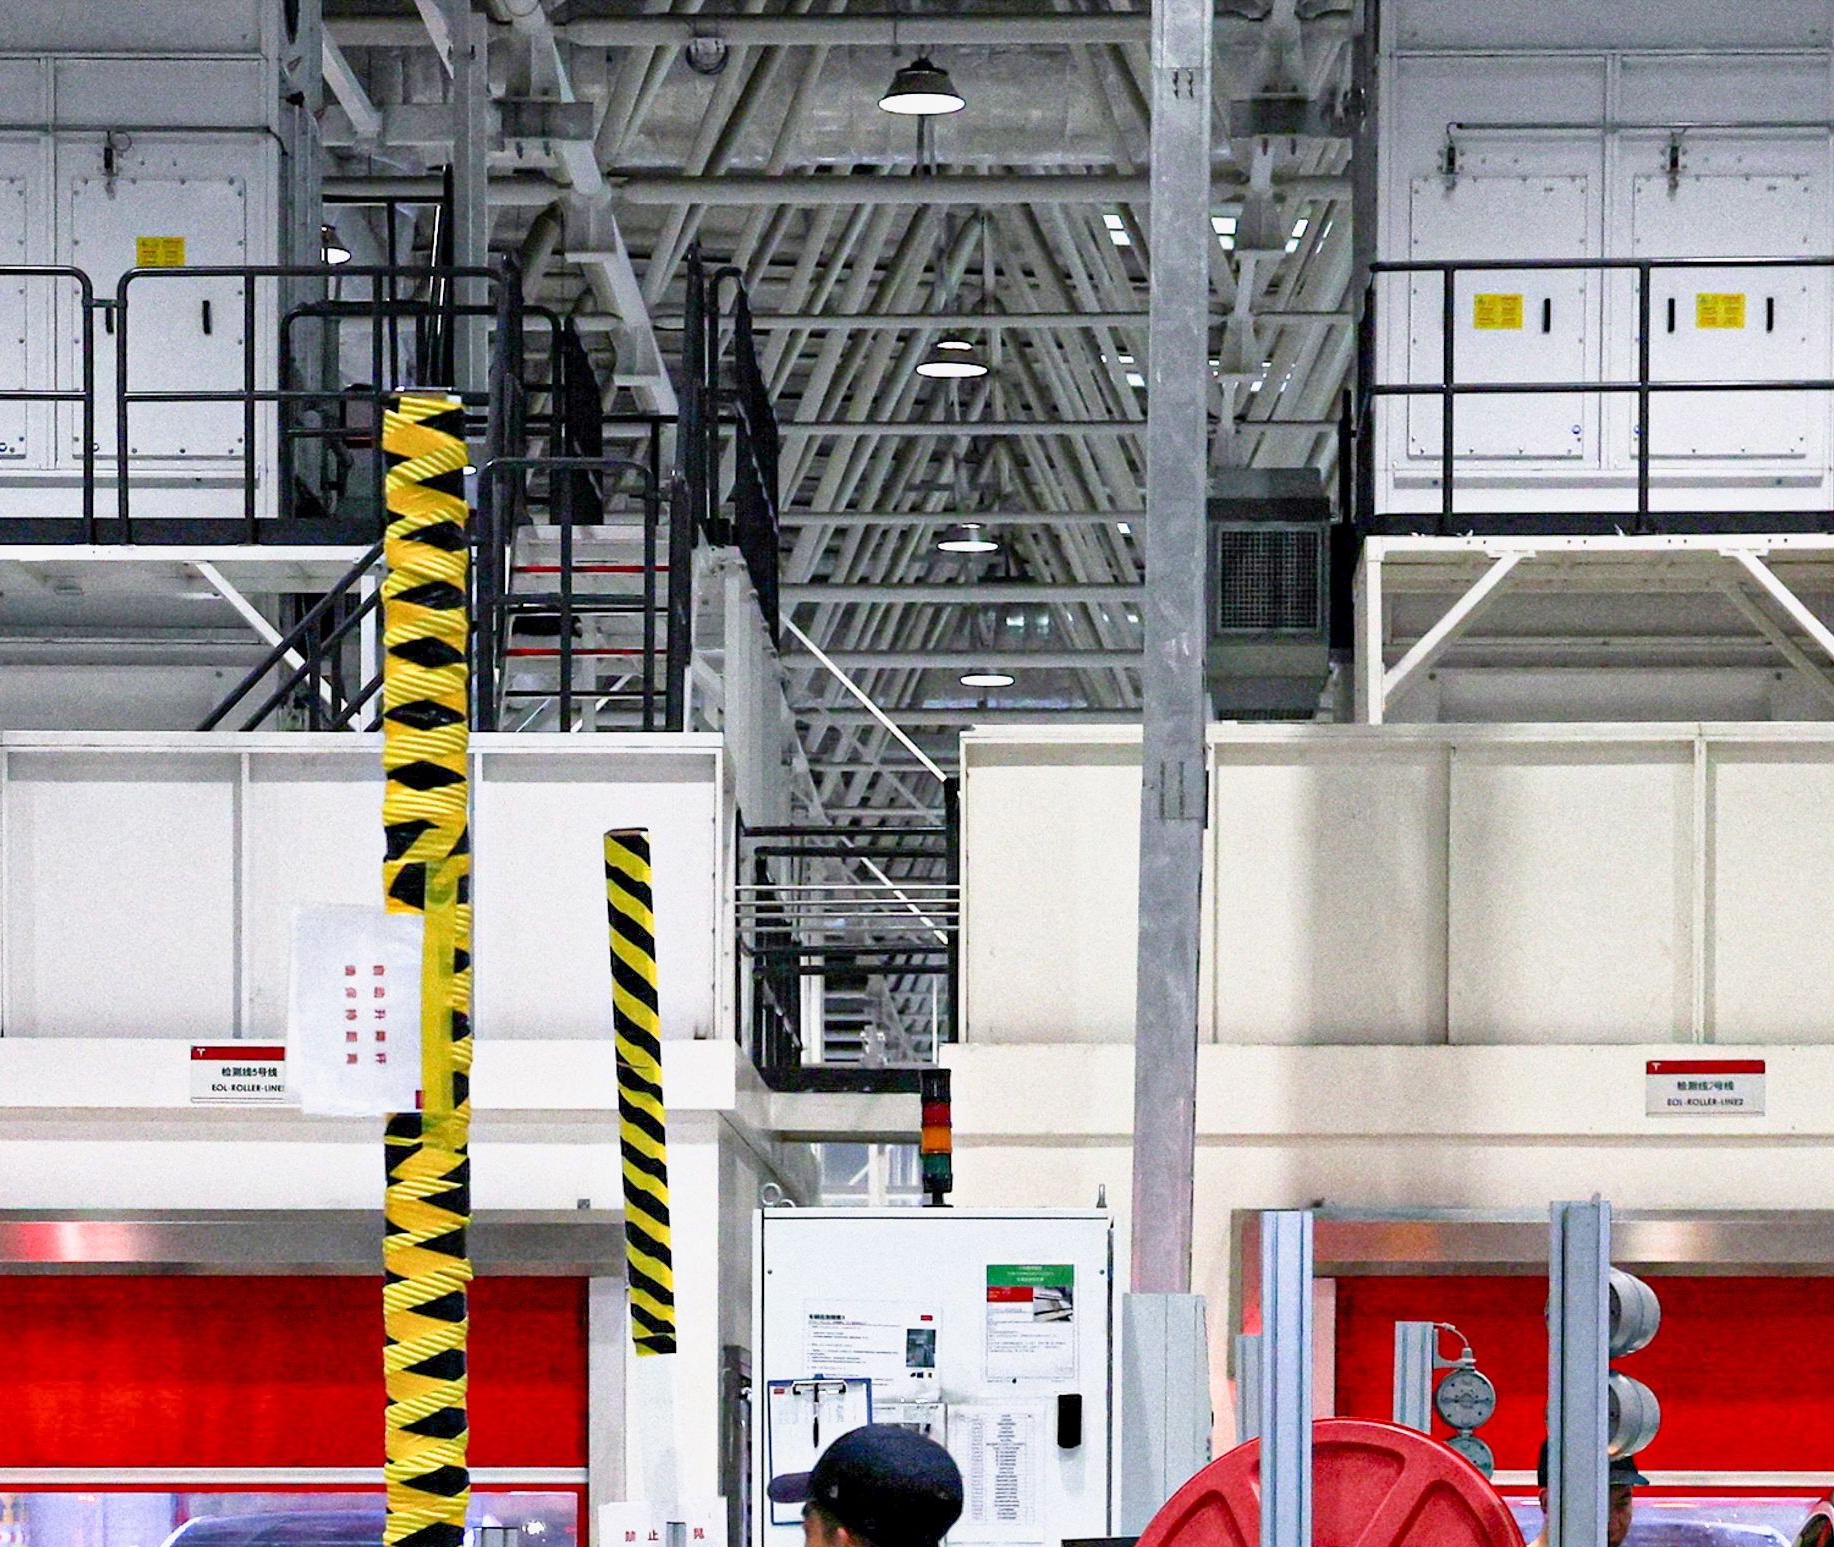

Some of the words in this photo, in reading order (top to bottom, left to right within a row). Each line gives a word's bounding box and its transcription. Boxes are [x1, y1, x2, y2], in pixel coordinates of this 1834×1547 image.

[221, 1067, 278, 1077] 检测线5号线
